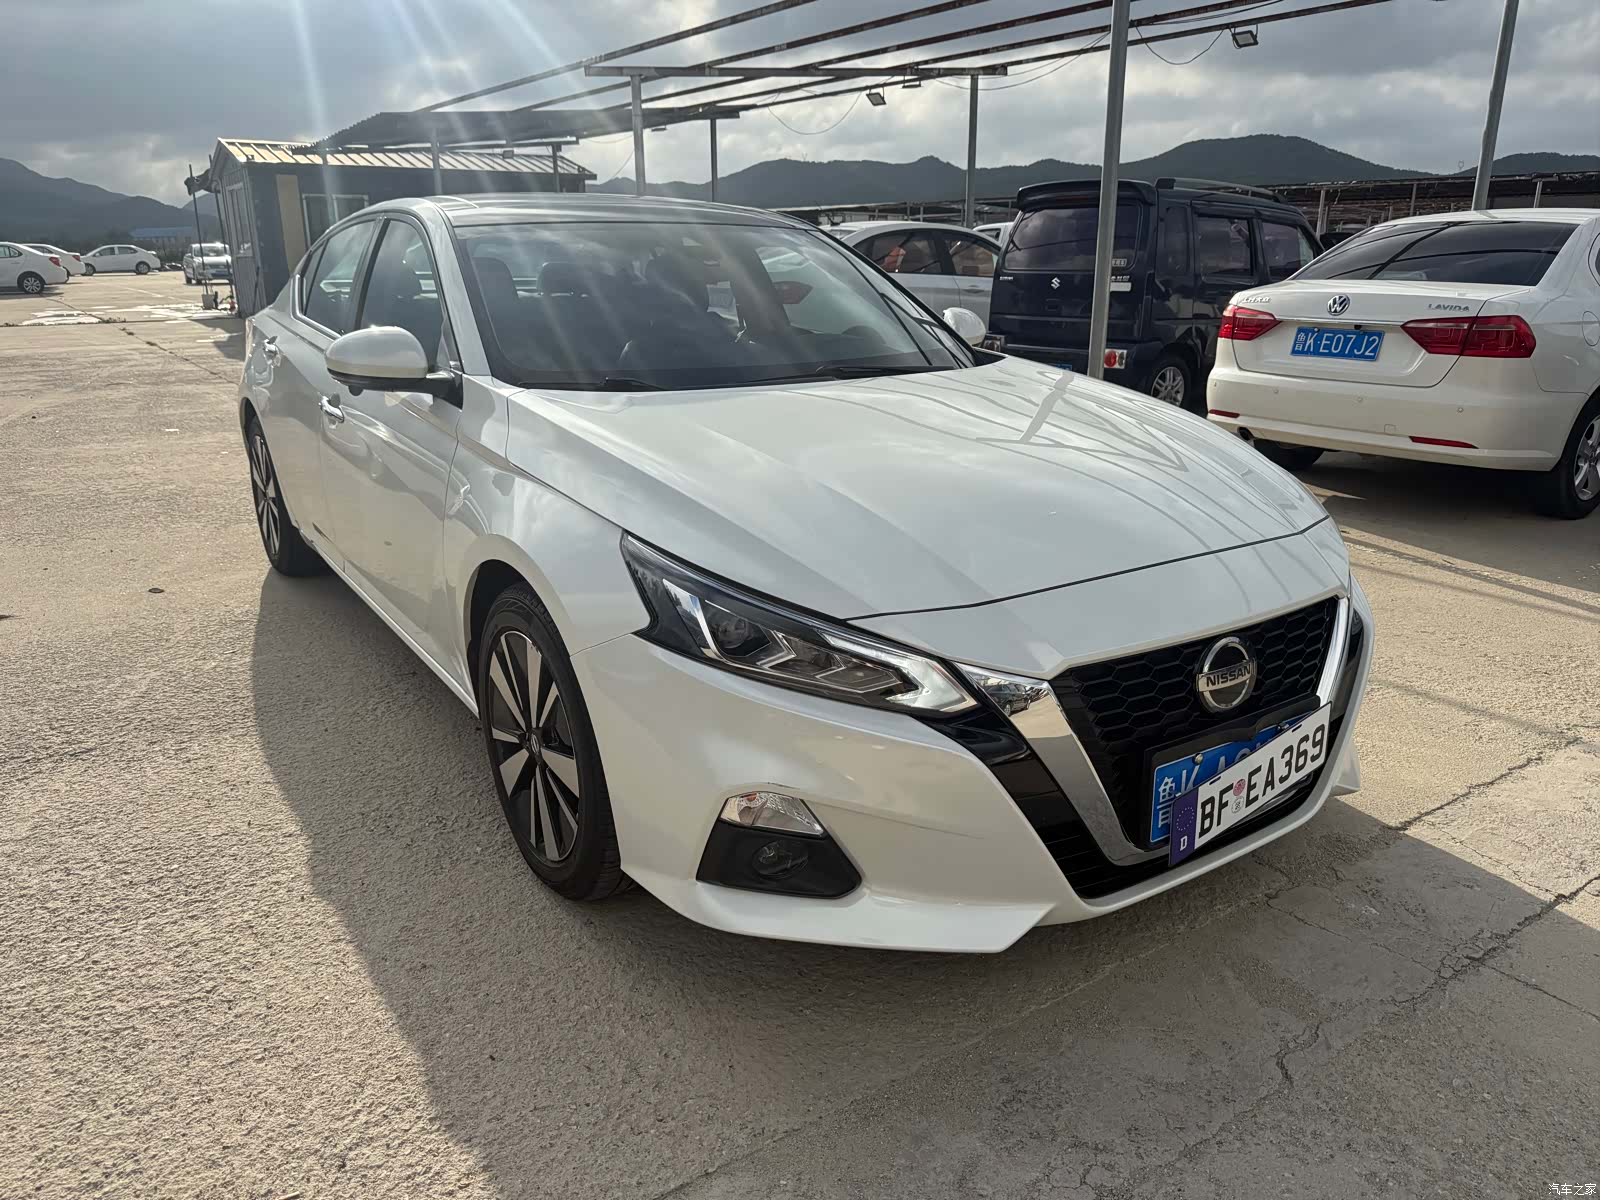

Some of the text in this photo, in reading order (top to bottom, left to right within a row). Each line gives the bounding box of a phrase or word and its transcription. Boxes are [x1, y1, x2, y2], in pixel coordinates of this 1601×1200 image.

[1427, 303, 1471, 312] LAVIDA
[1206, 663, 1251, 687] NISSAN
[1199, 782, 1234, 839] BF
[1245, 723, 1326, 809] EA369
